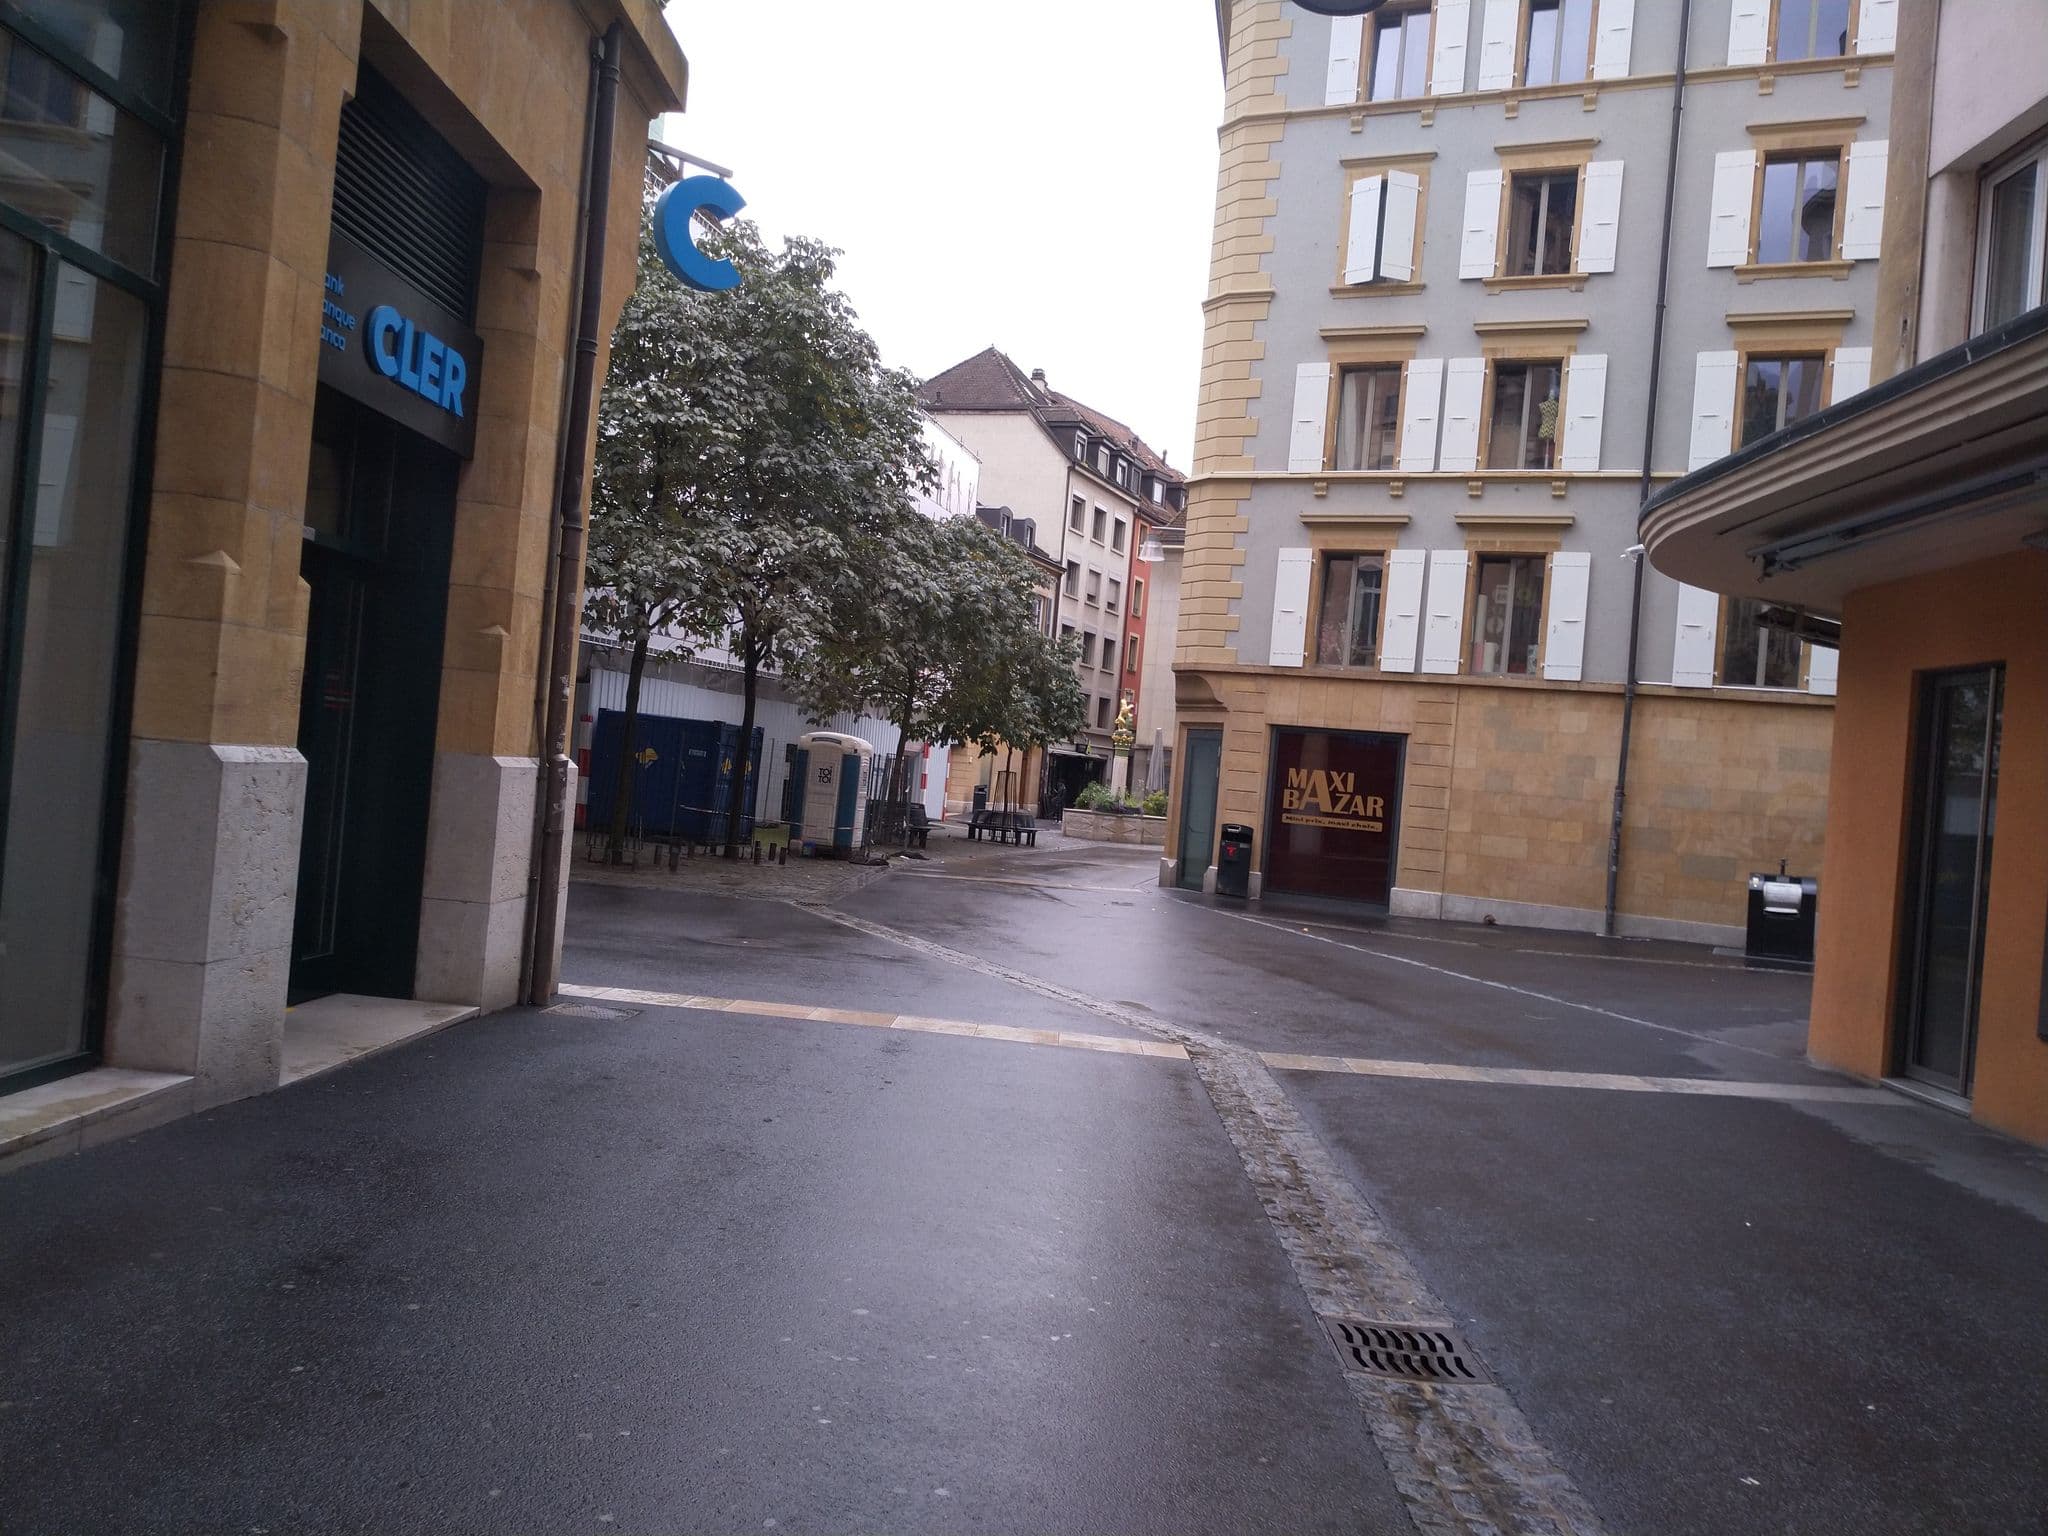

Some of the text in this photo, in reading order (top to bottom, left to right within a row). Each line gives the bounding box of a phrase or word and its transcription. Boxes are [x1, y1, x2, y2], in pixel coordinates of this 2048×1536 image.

[653, 175, 747, 291] C
[325, 272, 344, 297] ank
[322, 299, 356, 331] anque
[320, 325, 345, 352] anca
[367, 305, 467, 418] CLER
[1287, 768, 1355, 797] MAXI
[1282, 784, 1384, 818] BAZAR
